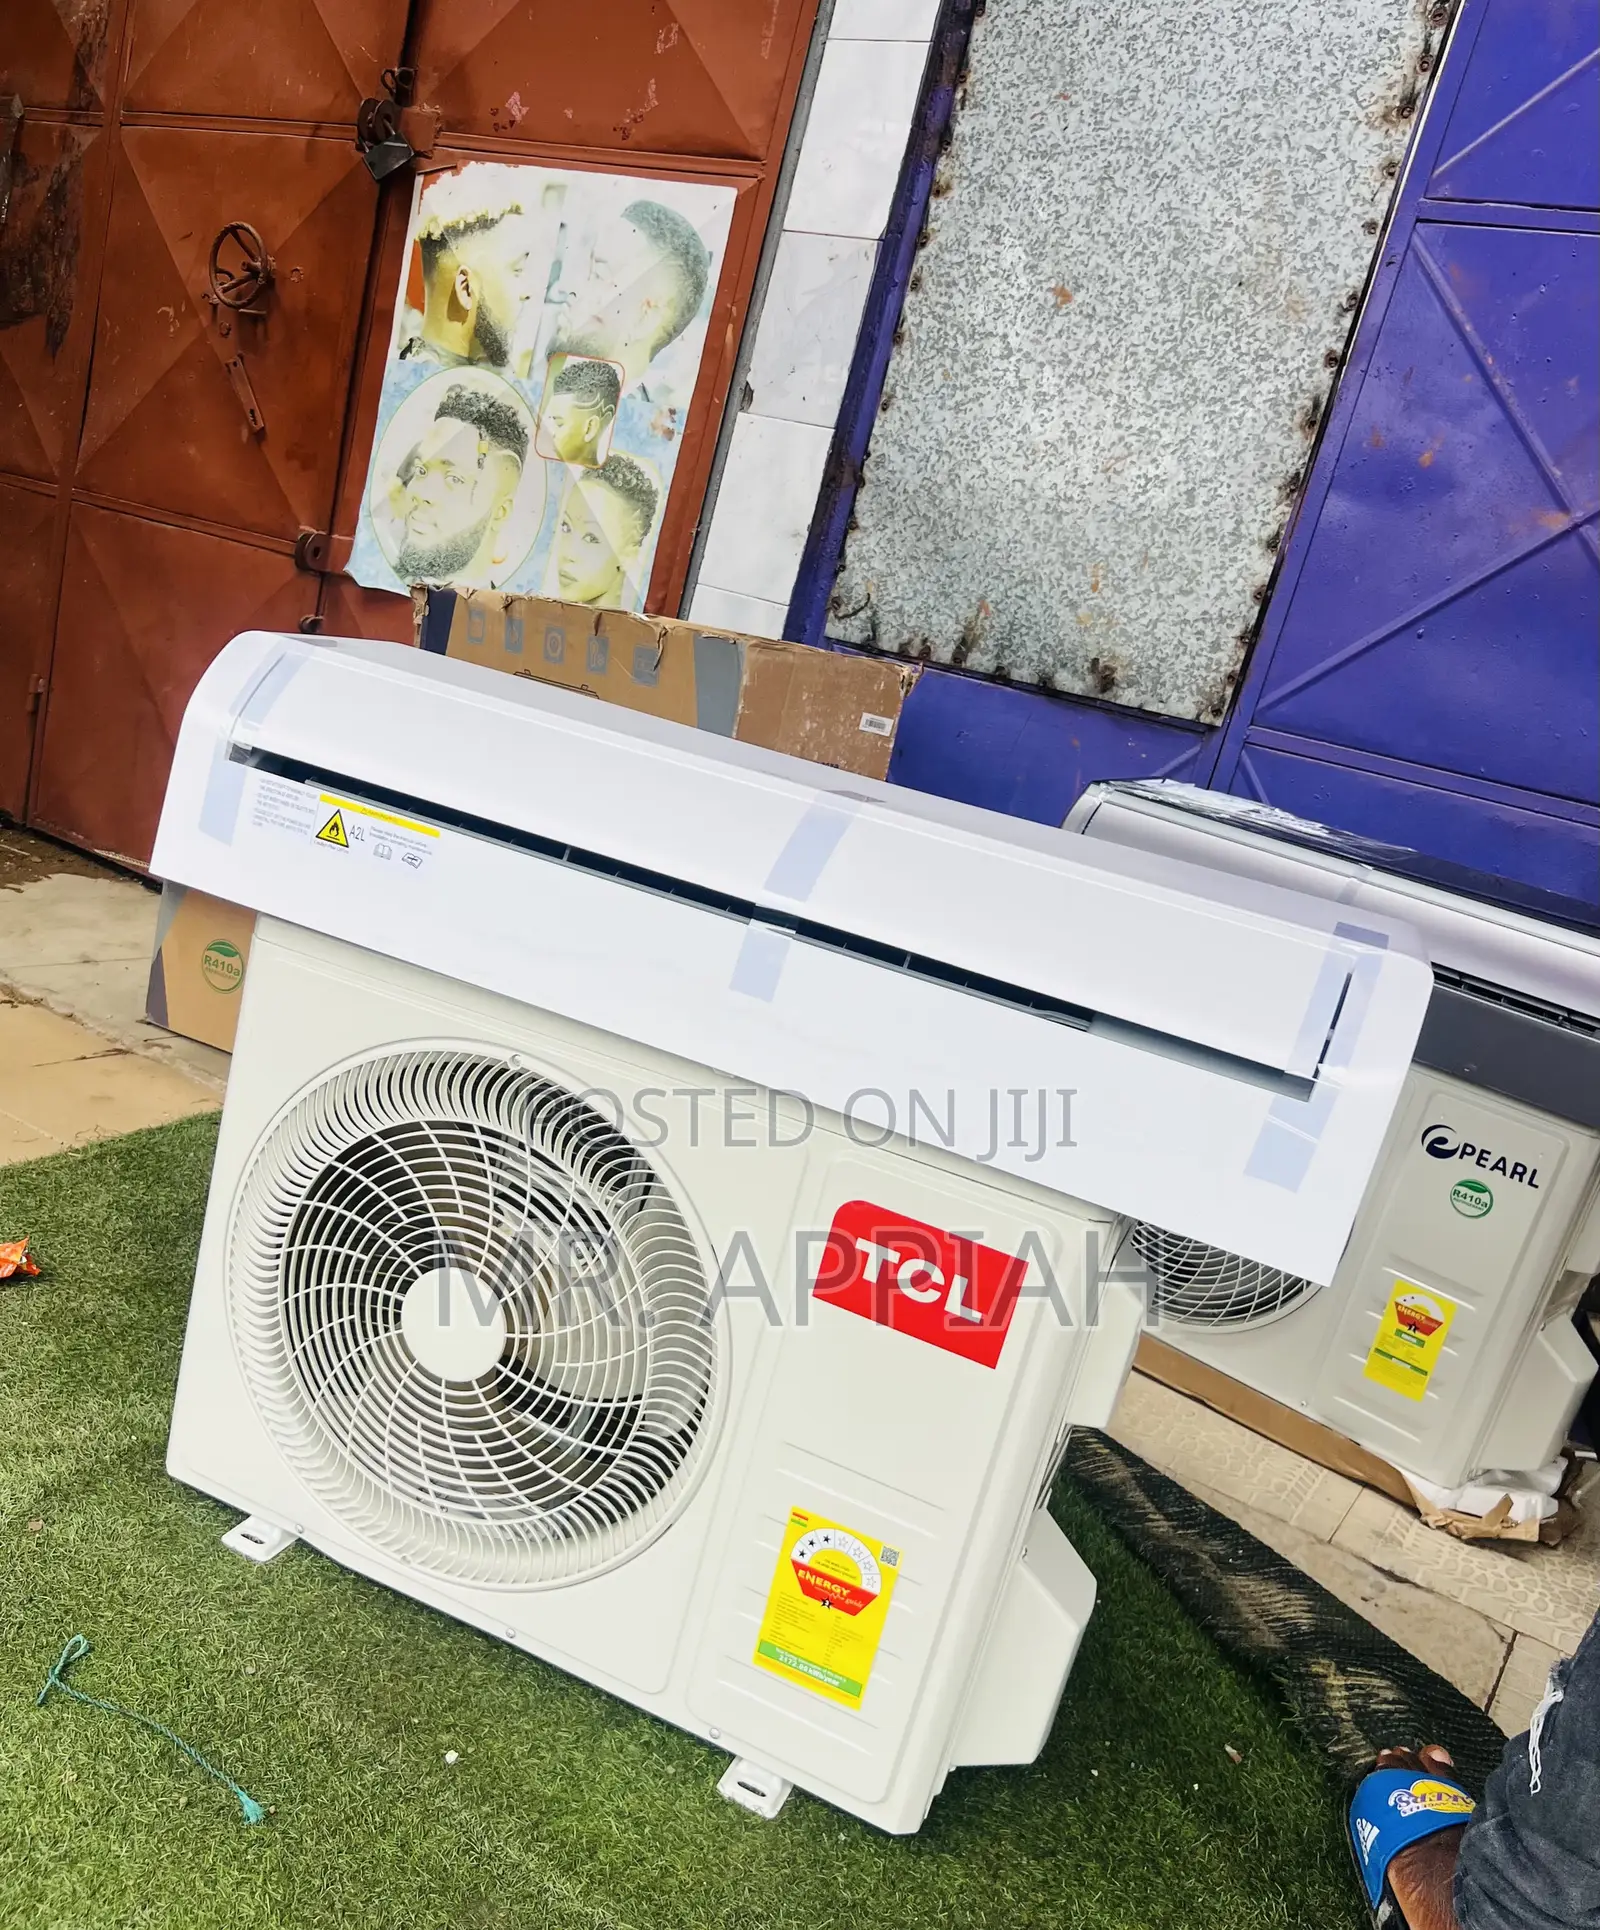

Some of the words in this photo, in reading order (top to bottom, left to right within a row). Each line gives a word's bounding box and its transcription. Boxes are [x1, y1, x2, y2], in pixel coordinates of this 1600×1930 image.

[349, 825, 365, 842] A2L
[204, 955, 241, 977] R410a
[1452, 1188, 1488, 1209] R410a
[855, 1237, 983, 1324] TCL
[798, 1569, 851, 1597] ENERGY
